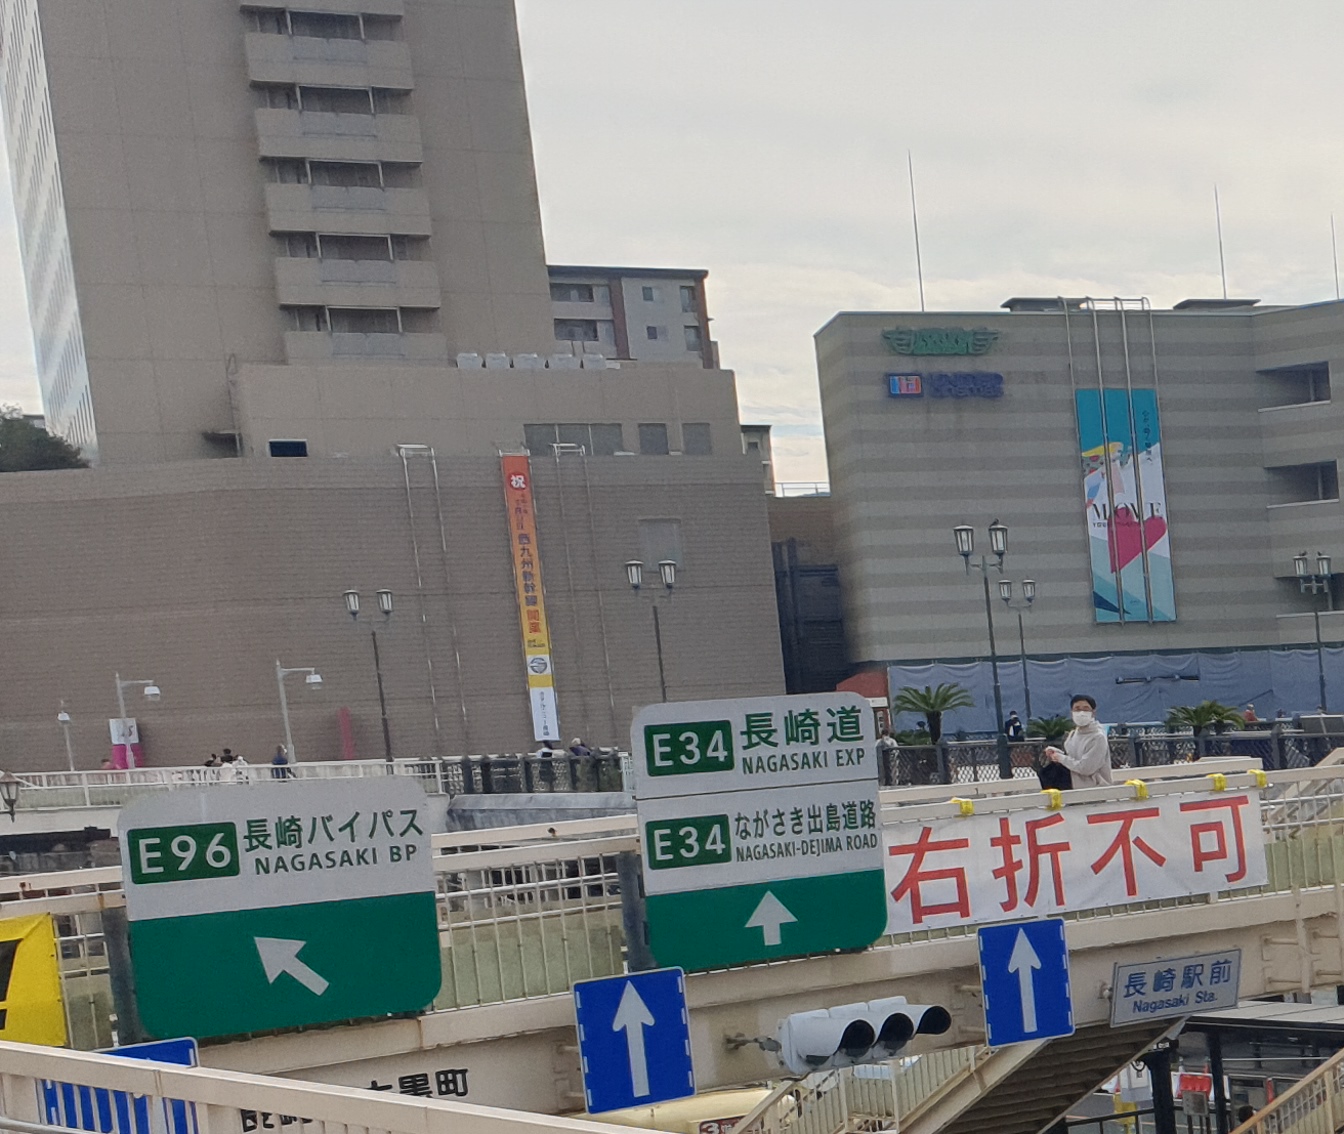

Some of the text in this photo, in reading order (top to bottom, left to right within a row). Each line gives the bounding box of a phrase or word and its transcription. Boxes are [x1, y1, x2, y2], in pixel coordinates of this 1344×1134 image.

[653, 705, 865, 767] E34 長崎道
[742, 748, 866, 775] NAGASAKI EXP
[138, 809, 424, 875] E96 長崎バイパス
[654, 799, 876, 861] E34 ながさき出島道路
[736, 833, 878, 862] NAGASAKI-DEJIMA ROAD
[254, 844, 418, 875] NAGASAKI BP
[889, 795, 1249, 924] 右折不可
[1123, 958, 1233, 999] 長崎駅前
[1132, 993, 1190, 1014] Nagasaki
